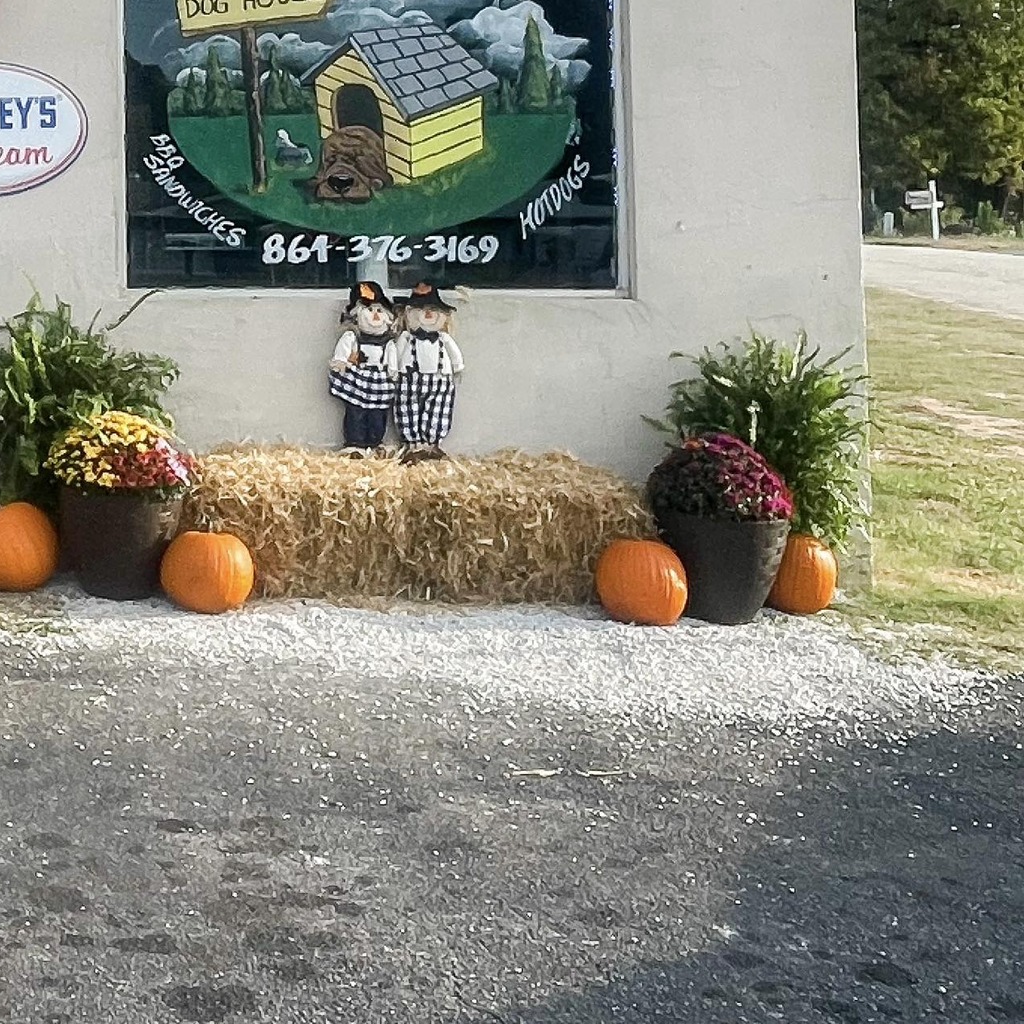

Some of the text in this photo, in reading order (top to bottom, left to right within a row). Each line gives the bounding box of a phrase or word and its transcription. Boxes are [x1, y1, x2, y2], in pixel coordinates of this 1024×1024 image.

[149, 134, 185, 171] BBQ
[143, 154, 246, 247] SANDWICHES
[519, 154, 590, 240] HOTDOGS
[262, 233, 499, 264] 864-376-3169
